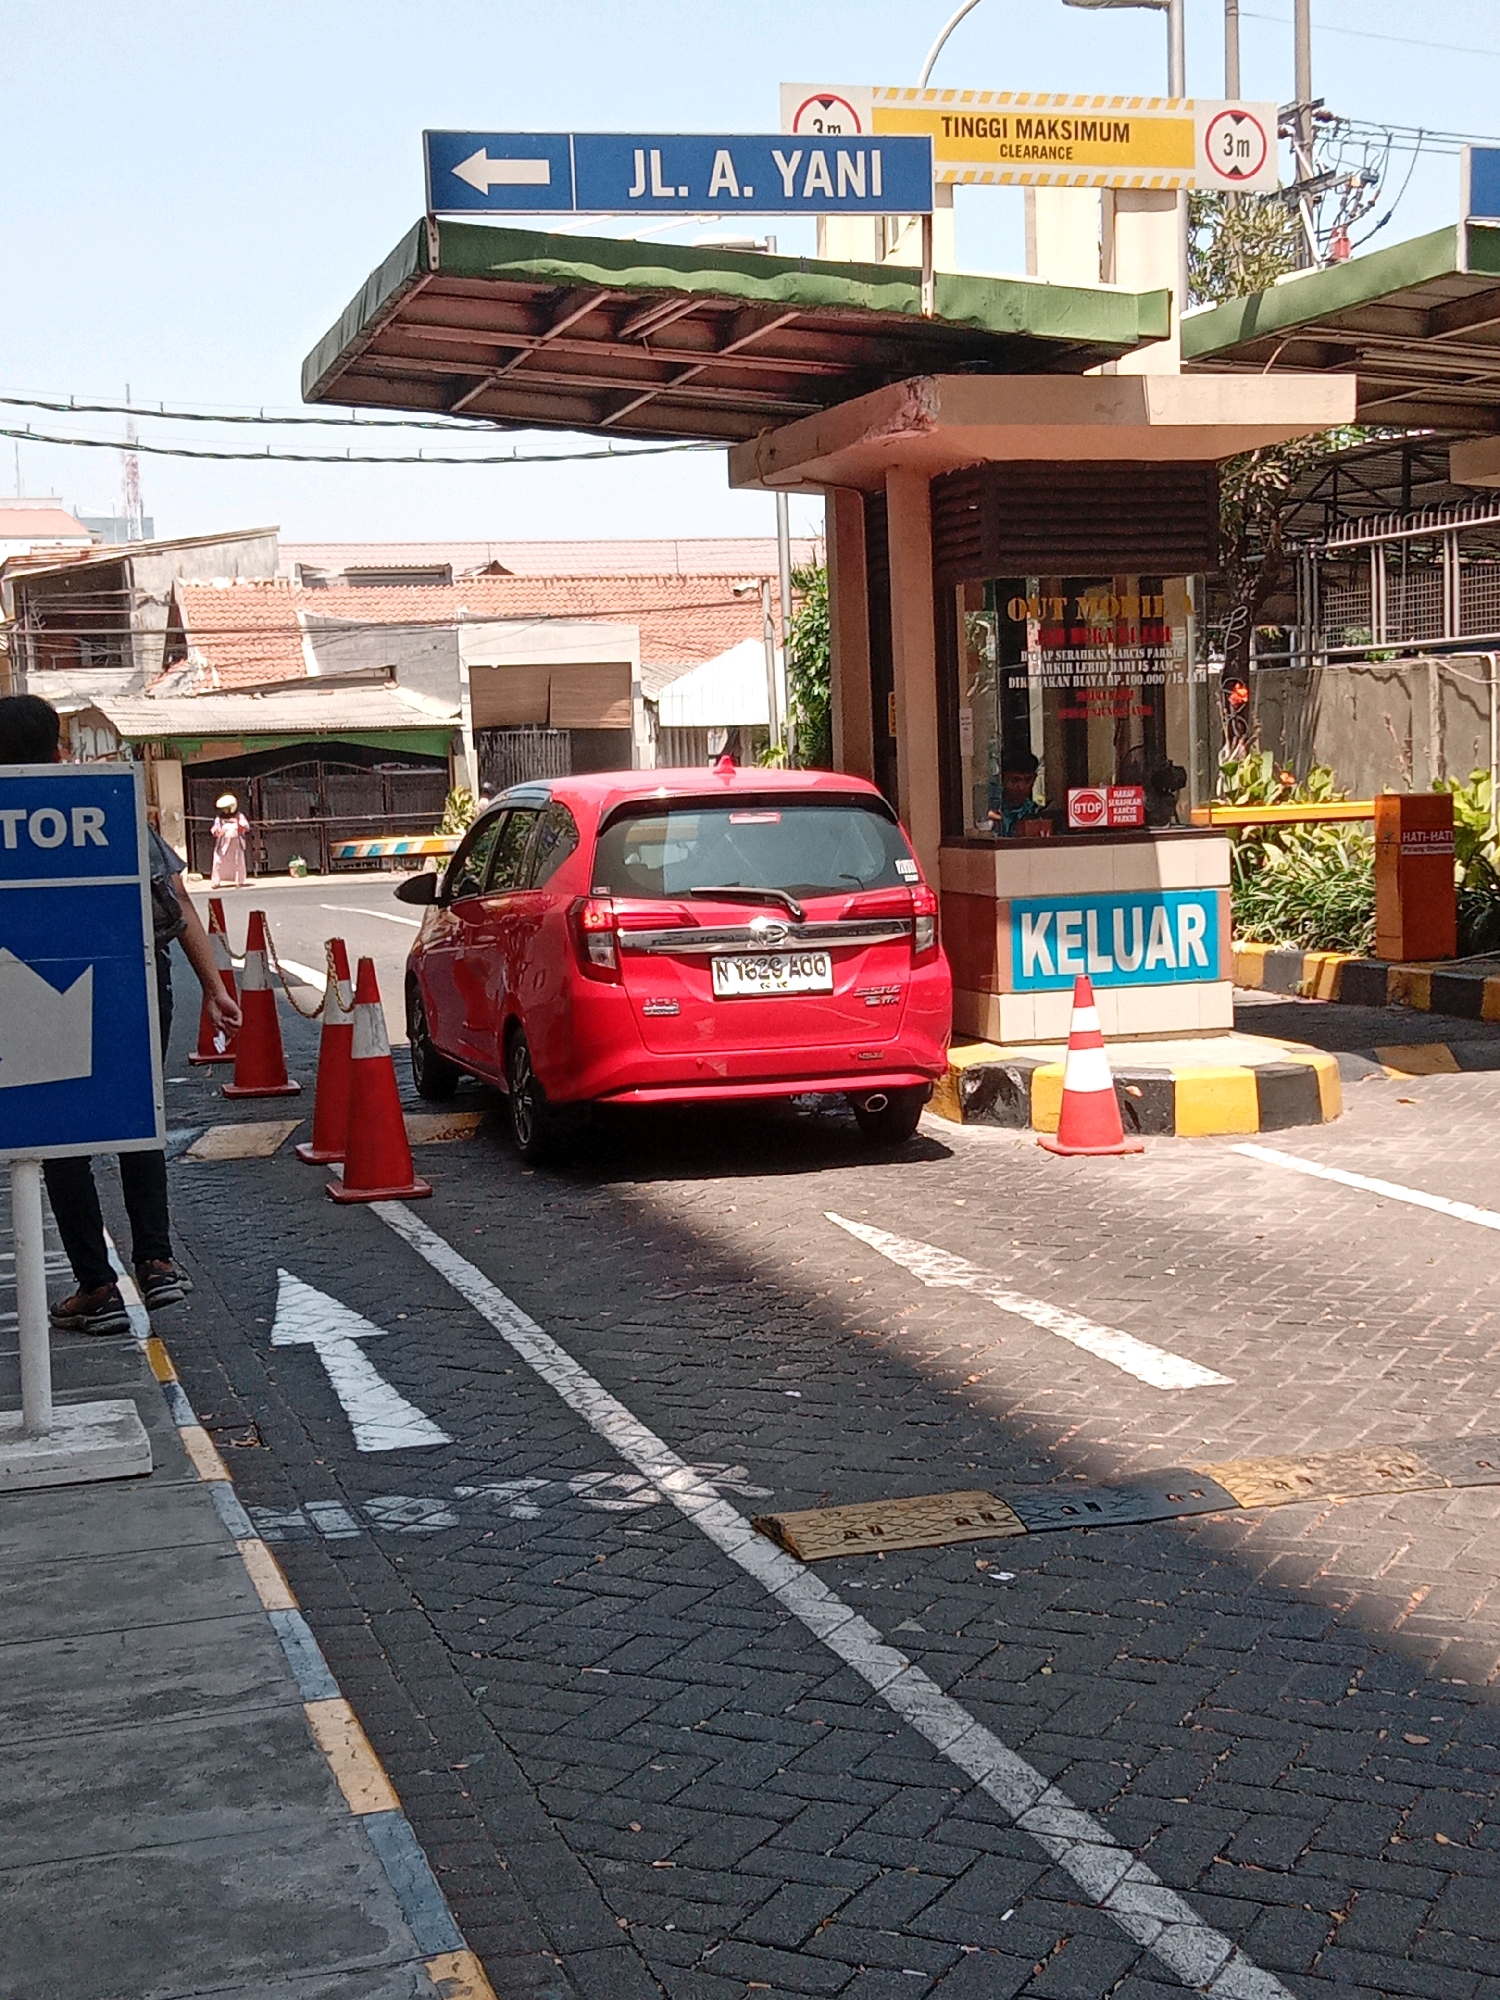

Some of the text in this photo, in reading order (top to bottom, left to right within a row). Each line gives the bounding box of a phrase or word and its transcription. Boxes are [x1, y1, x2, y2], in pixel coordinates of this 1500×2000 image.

[940, 116, 1131, 144] TINGGI MAKSIMUM
[999, 143, 1074, 161] CLEARANCE
[628, 149, 882, 198] JL. A. YANI
[1006, 595, 1068, 622] OUT
[1074, 802, 1102, 814] STOP
[0, 807, 109, 849] TOR
[1402, 830, 1454, 842] HATI-HATI
[1020, 903, 1210, 978] KELUAR
